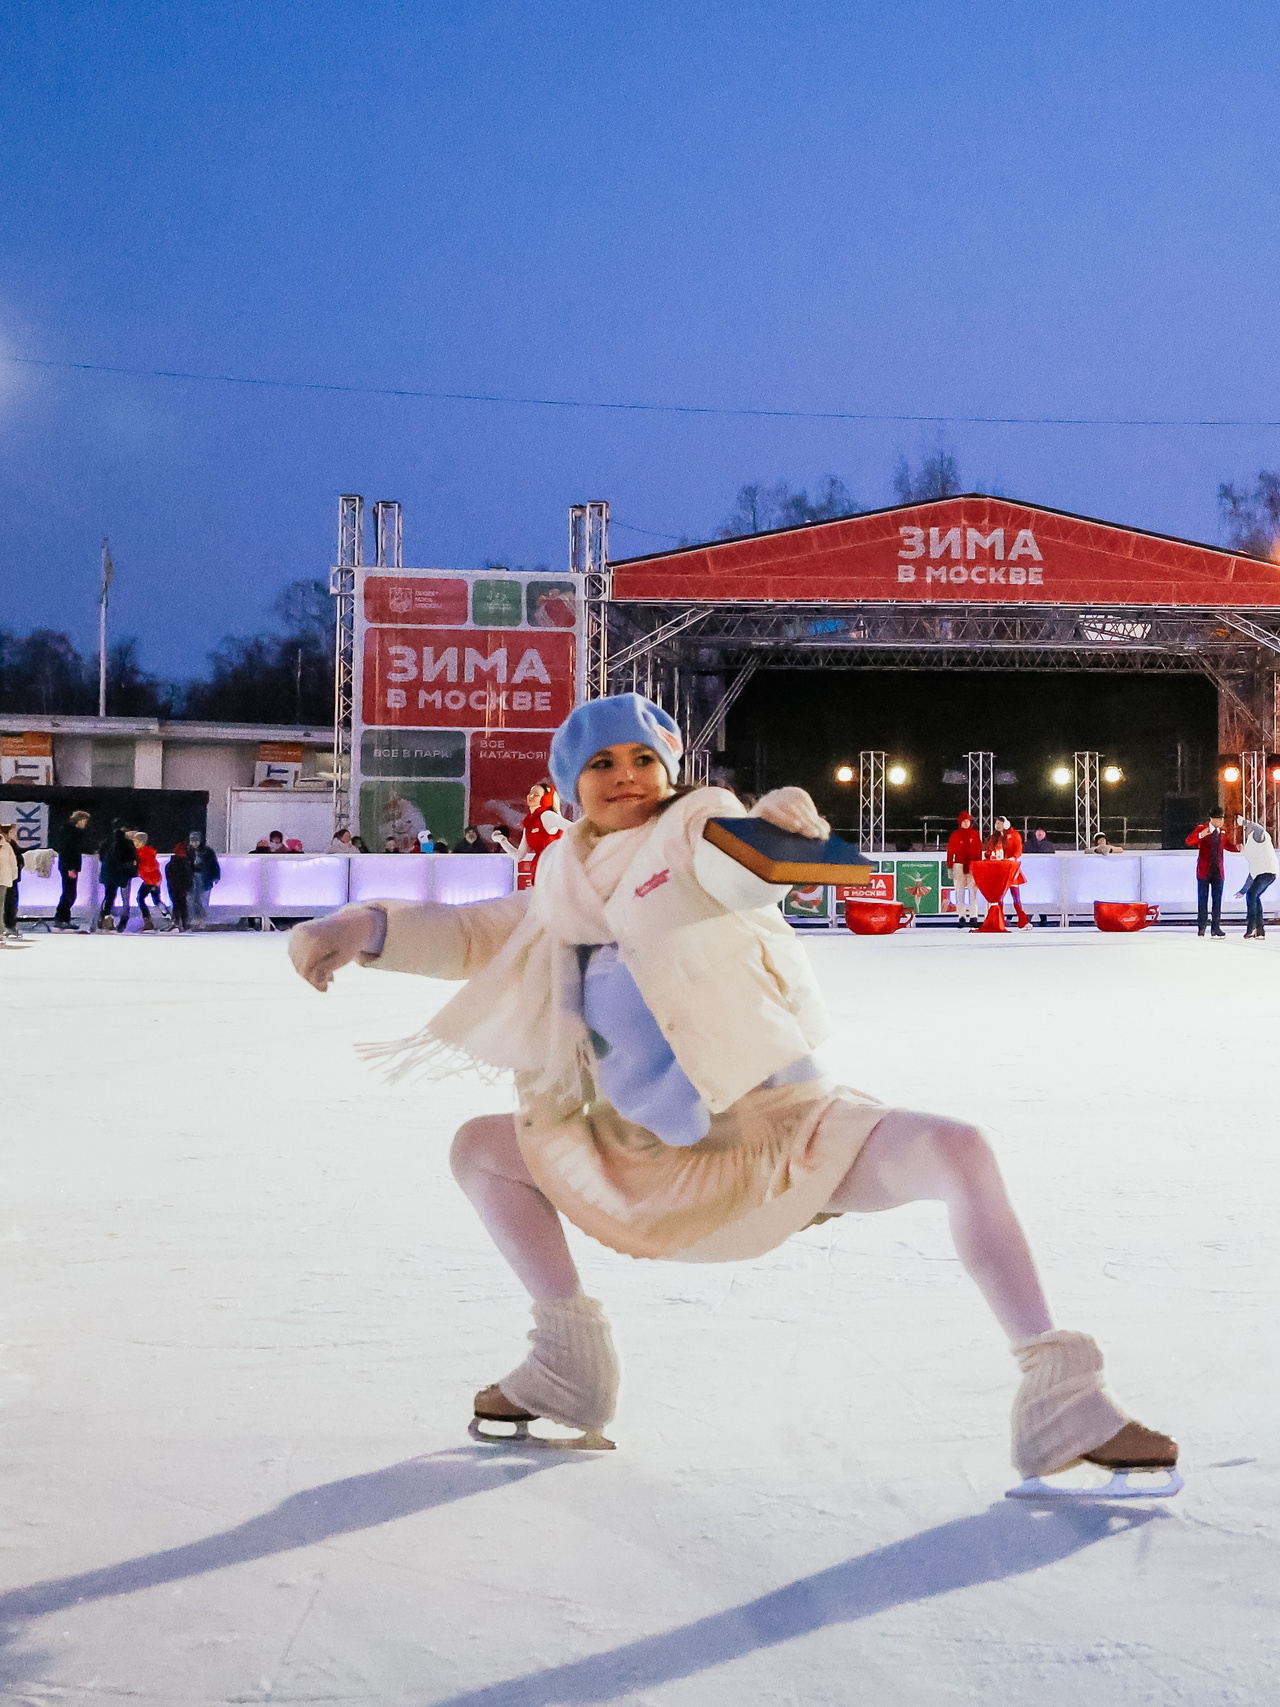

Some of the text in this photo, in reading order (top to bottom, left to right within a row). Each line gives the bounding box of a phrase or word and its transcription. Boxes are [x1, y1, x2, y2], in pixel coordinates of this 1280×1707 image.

[897, 526, 1044, 561] ЗИМА
[897, 564, 1044, 585] В МОСКВЕ
[386, 645, 552, 684] ЗИМА
[386, 689, 552, 711] В МОСКВЕ
[373, 749, 399, 758] ВСЕ
[402, 750, 411, 758] В
[479, 740, 505, 749] ВСЕ
[479, 751, 547, 760] КАТАТЬСЯ!
